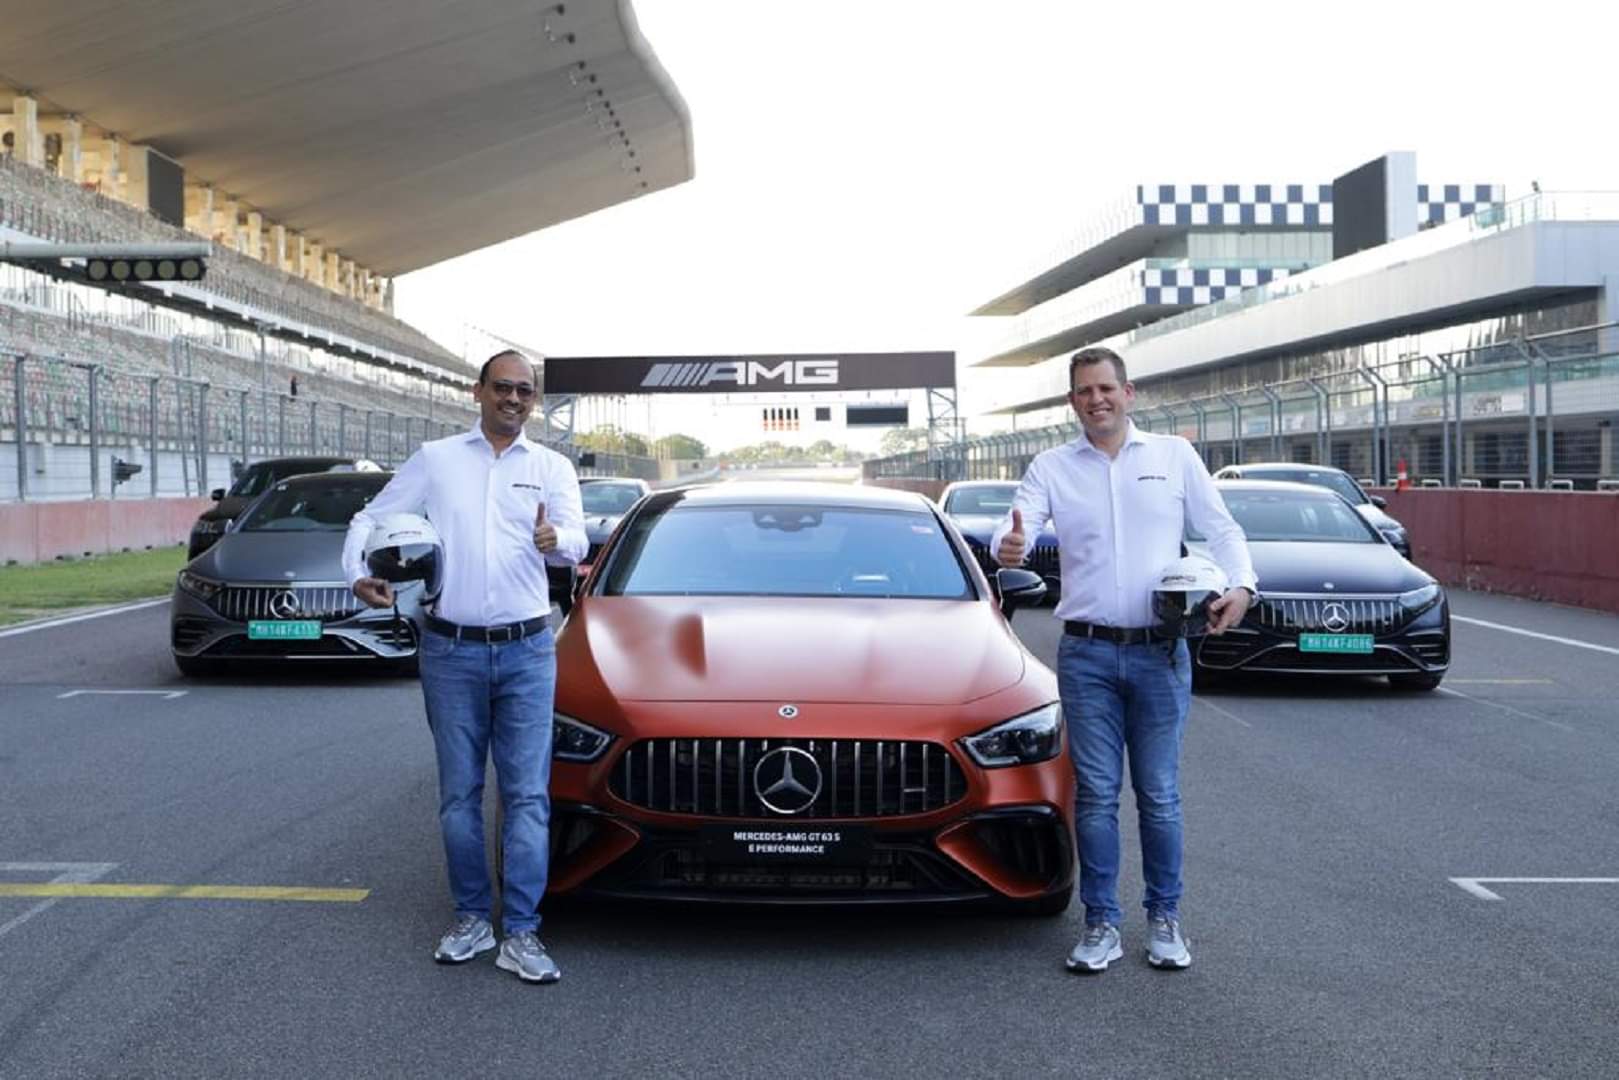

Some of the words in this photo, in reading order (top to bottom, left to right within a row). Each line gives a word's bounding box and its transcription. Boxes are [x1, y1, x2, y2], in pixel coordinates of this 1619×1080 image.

[700, 361, 839, 386] AMG
[733, 832, 807, 841] MERCEDES-AMG
[808, 832, 820, 841] GT
[821, 832, 833, 841] 63
[834, 832, 841, 841] S
[748, 844, 755, 853] E
[756, 844, 825, 854] PERFORMANCE
